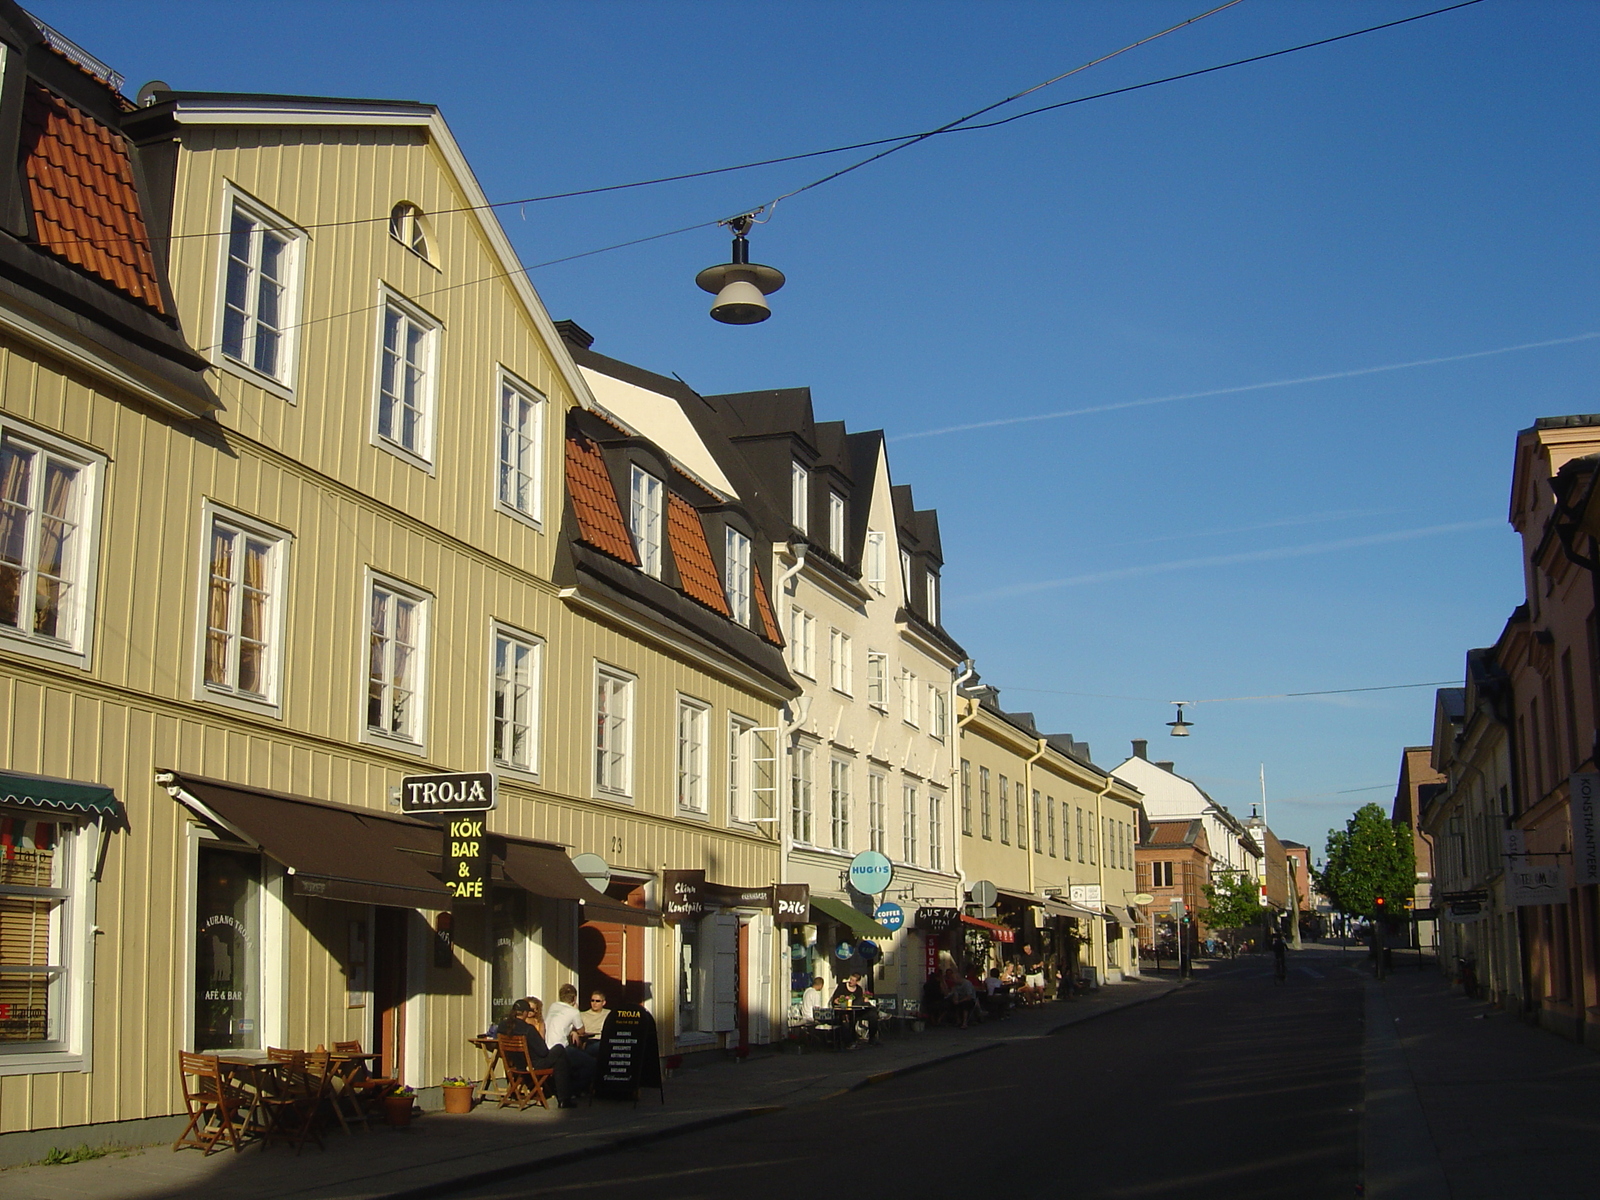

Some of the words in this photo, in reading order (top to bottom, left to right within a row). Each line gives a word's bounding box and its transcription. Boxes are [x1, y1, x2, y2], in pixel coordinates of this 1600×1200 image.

[407, 780, 487, 805] TROJA
[450, 817, 483, 838] KÖK
[1580, 778, 1598, 880] KONSTHANTVERK
[451, 842, 480, 858] BAR
[611, 836, 623, 854] 23
[458, 861, 470, 878] &
[778, 899, 806, 916] Päls
[877, 909, 901, 919] COFFEE
[889, 916, 901, 925] GO
[220, 991, 226, 1001] &
[227, 991, 243, 1001] BAR
[617, 1010, 641, 1018] TROJA
